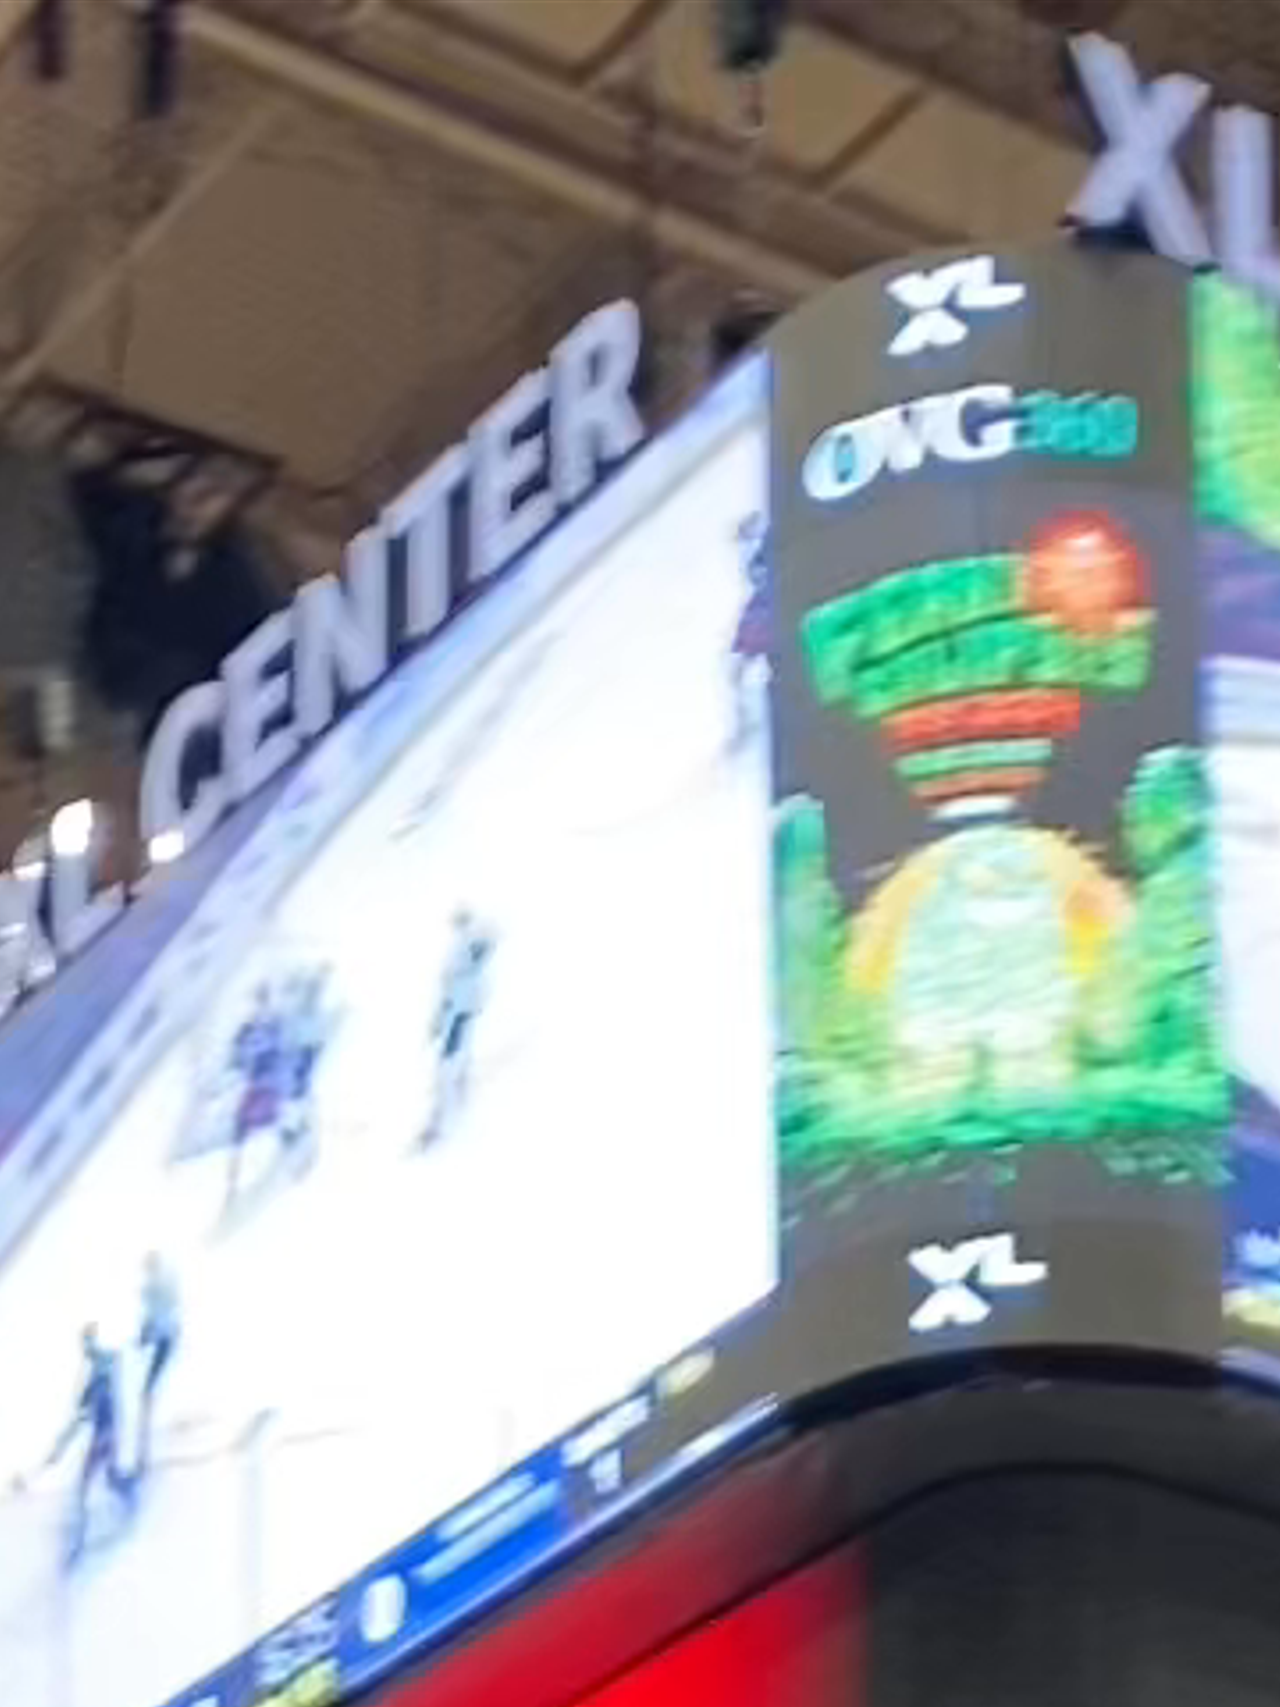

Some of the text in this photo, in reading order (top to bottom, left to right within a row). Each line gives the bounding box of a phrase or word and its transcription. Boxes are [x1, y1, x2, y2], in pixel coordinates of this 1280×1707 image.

[885, 255, 1025, 356] XL
[138, 297, 646, 864] CENTER
[908, 1232, 1049, 1331] XL
